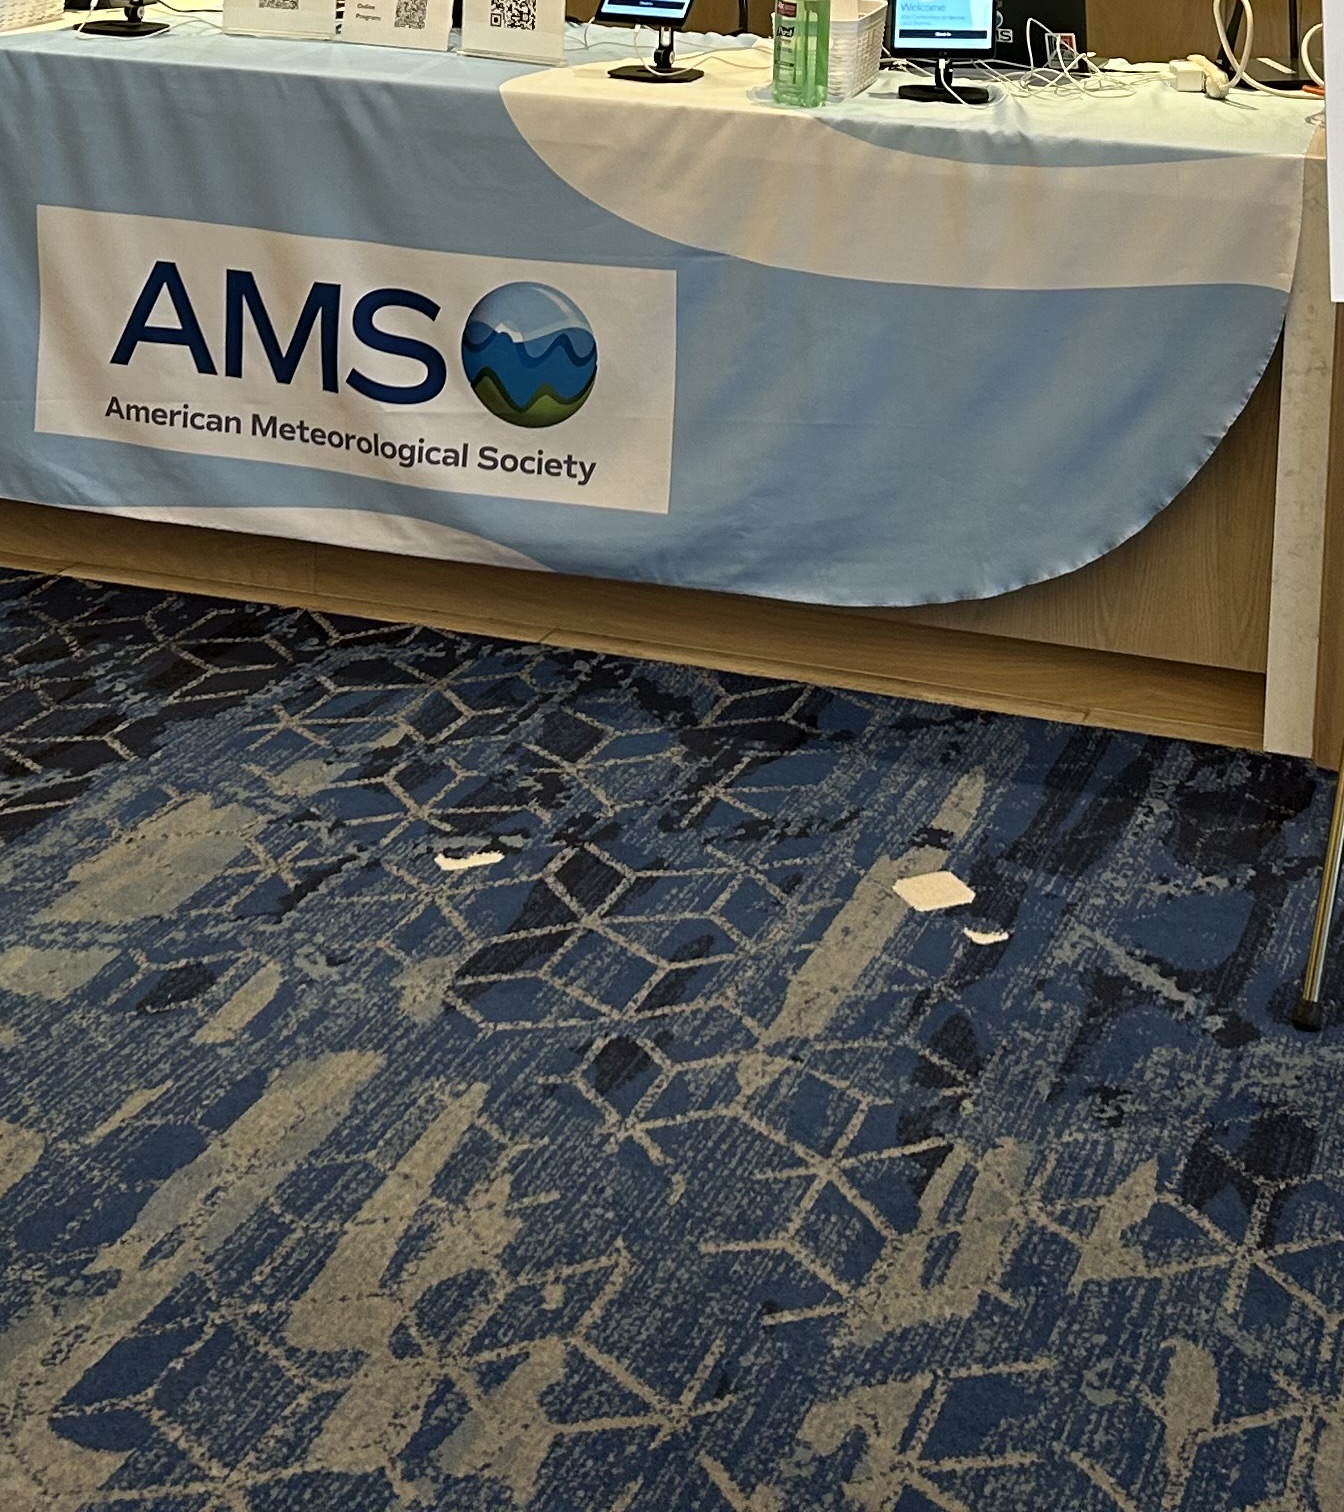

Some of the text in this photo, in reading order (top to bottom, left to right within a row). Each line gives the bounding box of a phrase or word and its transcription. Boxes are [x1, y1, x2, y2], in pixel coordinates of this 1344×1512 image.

[901, 3, 946, 12] Welcome
[109, 260, 447, 406] AMS
[105, 396, 597, 486] American Meteorological Society
